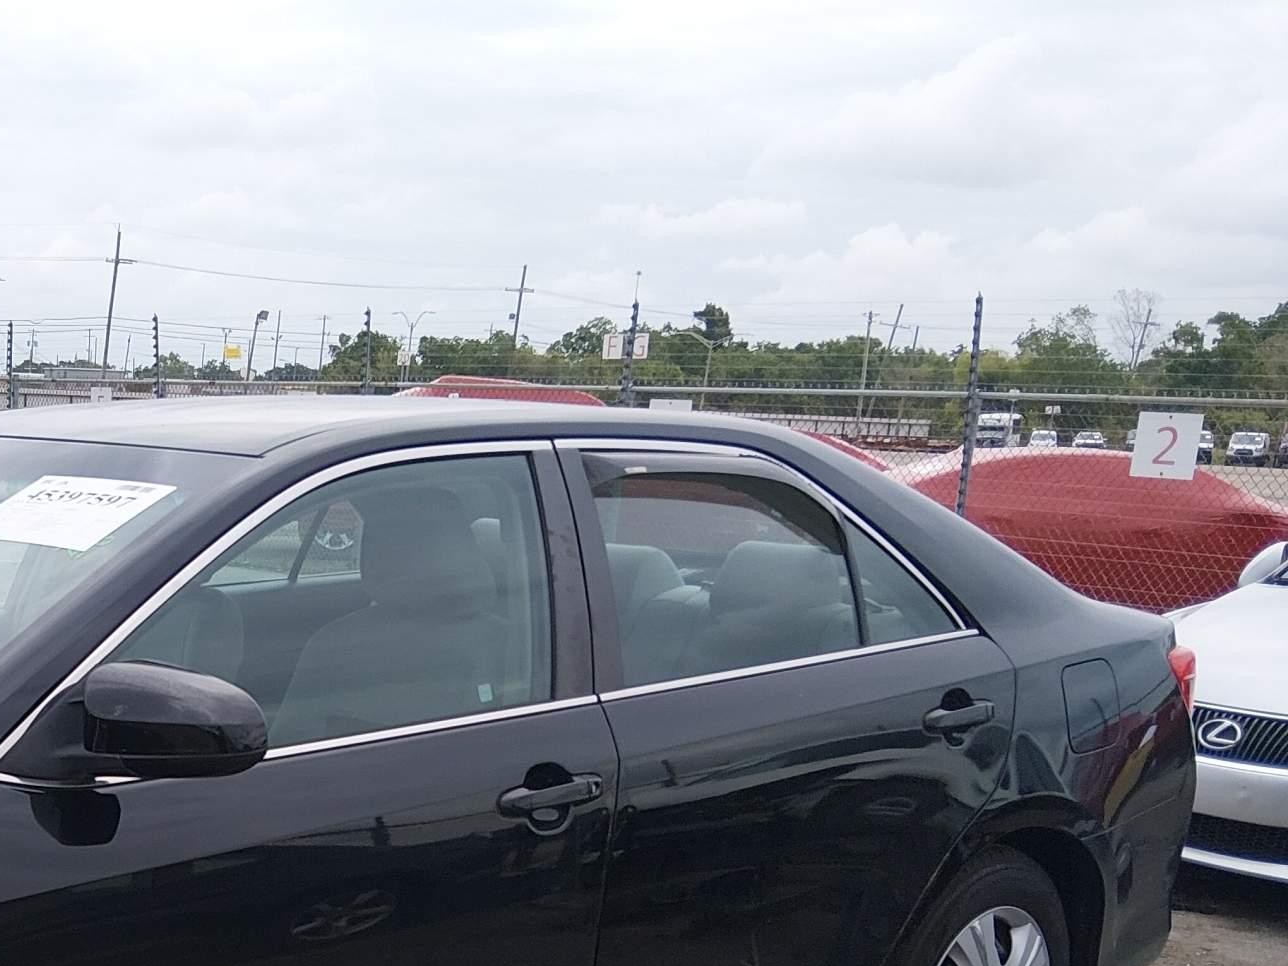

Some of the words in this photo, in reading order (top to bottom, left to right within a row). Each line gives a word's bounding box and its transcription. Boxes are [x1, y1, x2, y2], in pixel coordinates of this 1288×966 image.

[607, 335, 618, 357] F
[633, 335, 647, 357] G
[1152, 425, 1179, 466] 2
[27, 489, 138, 508] 45397597
